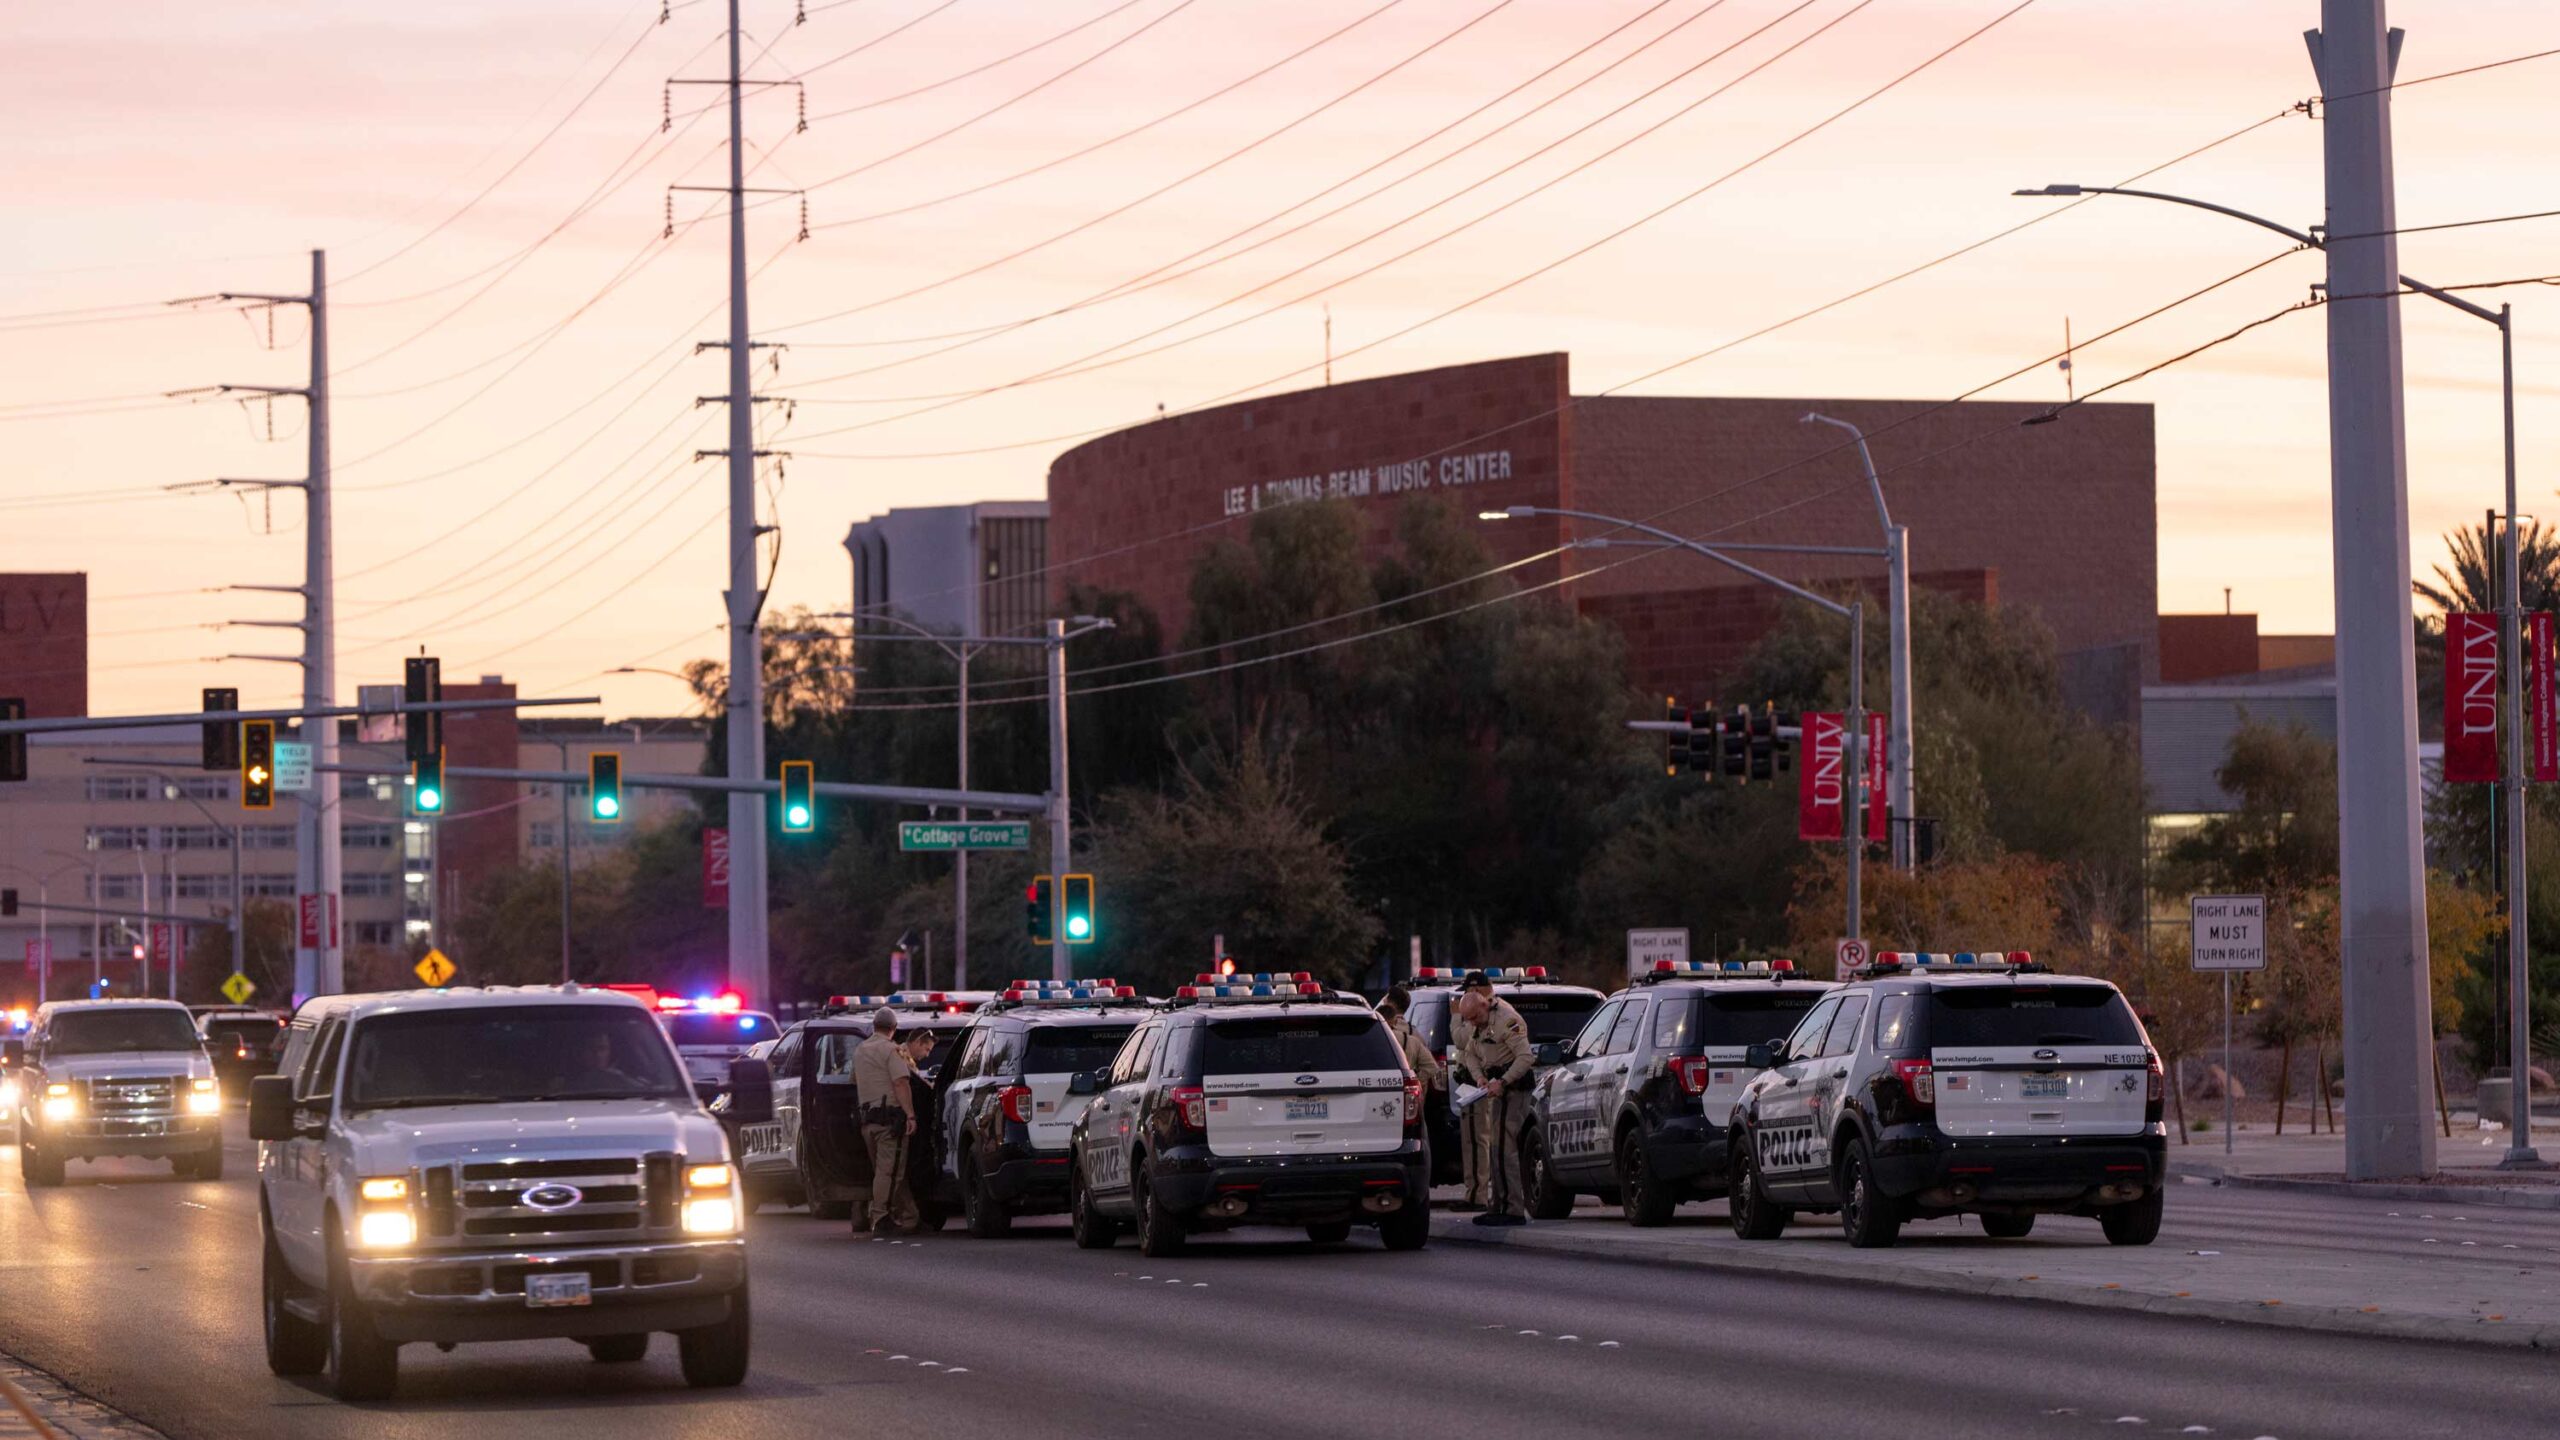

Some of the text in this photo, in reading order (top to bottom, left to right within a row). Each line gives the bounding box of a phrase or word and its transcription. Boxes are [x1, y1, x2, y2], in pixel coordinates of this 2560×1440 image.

[1224, 486, 1245, 515] LEE
[1266, 475, 1322, 503] THOMAS
[1329, 468, 1370, 498] BEAM
[1378, 460, 1431, 493] MUSIC
[1440, 451, 1511, 485] CENTER
[2462, 614, 2497, 738] UNLV
[1814, 713, 1844, 808] UNLV
[913, 828, 965, 848] Cottage
[970, 827, 1009, 842] Grove
[711, 829, 729, 886] UNLV
[2197, 905, 2260, 917] RIGHT LANE
[1633, 937, 1682, 947] RIGHT LANE
[2210, 926, 2248, 940] MUST
[2197, 948, 2261, 960] TURN RIGHT
[2104, 1054, 2147, 1063] NE 10733
[1358, 1077, 1402, 1087] NE 10654
[742, 1126, 782, 1156] POLICE
[1550, 1119, 1597, 1154] POLICE
[1760, 1128, 1812, 1167] POLICE
[1088, 1147, 1119, 1185] POLICE
